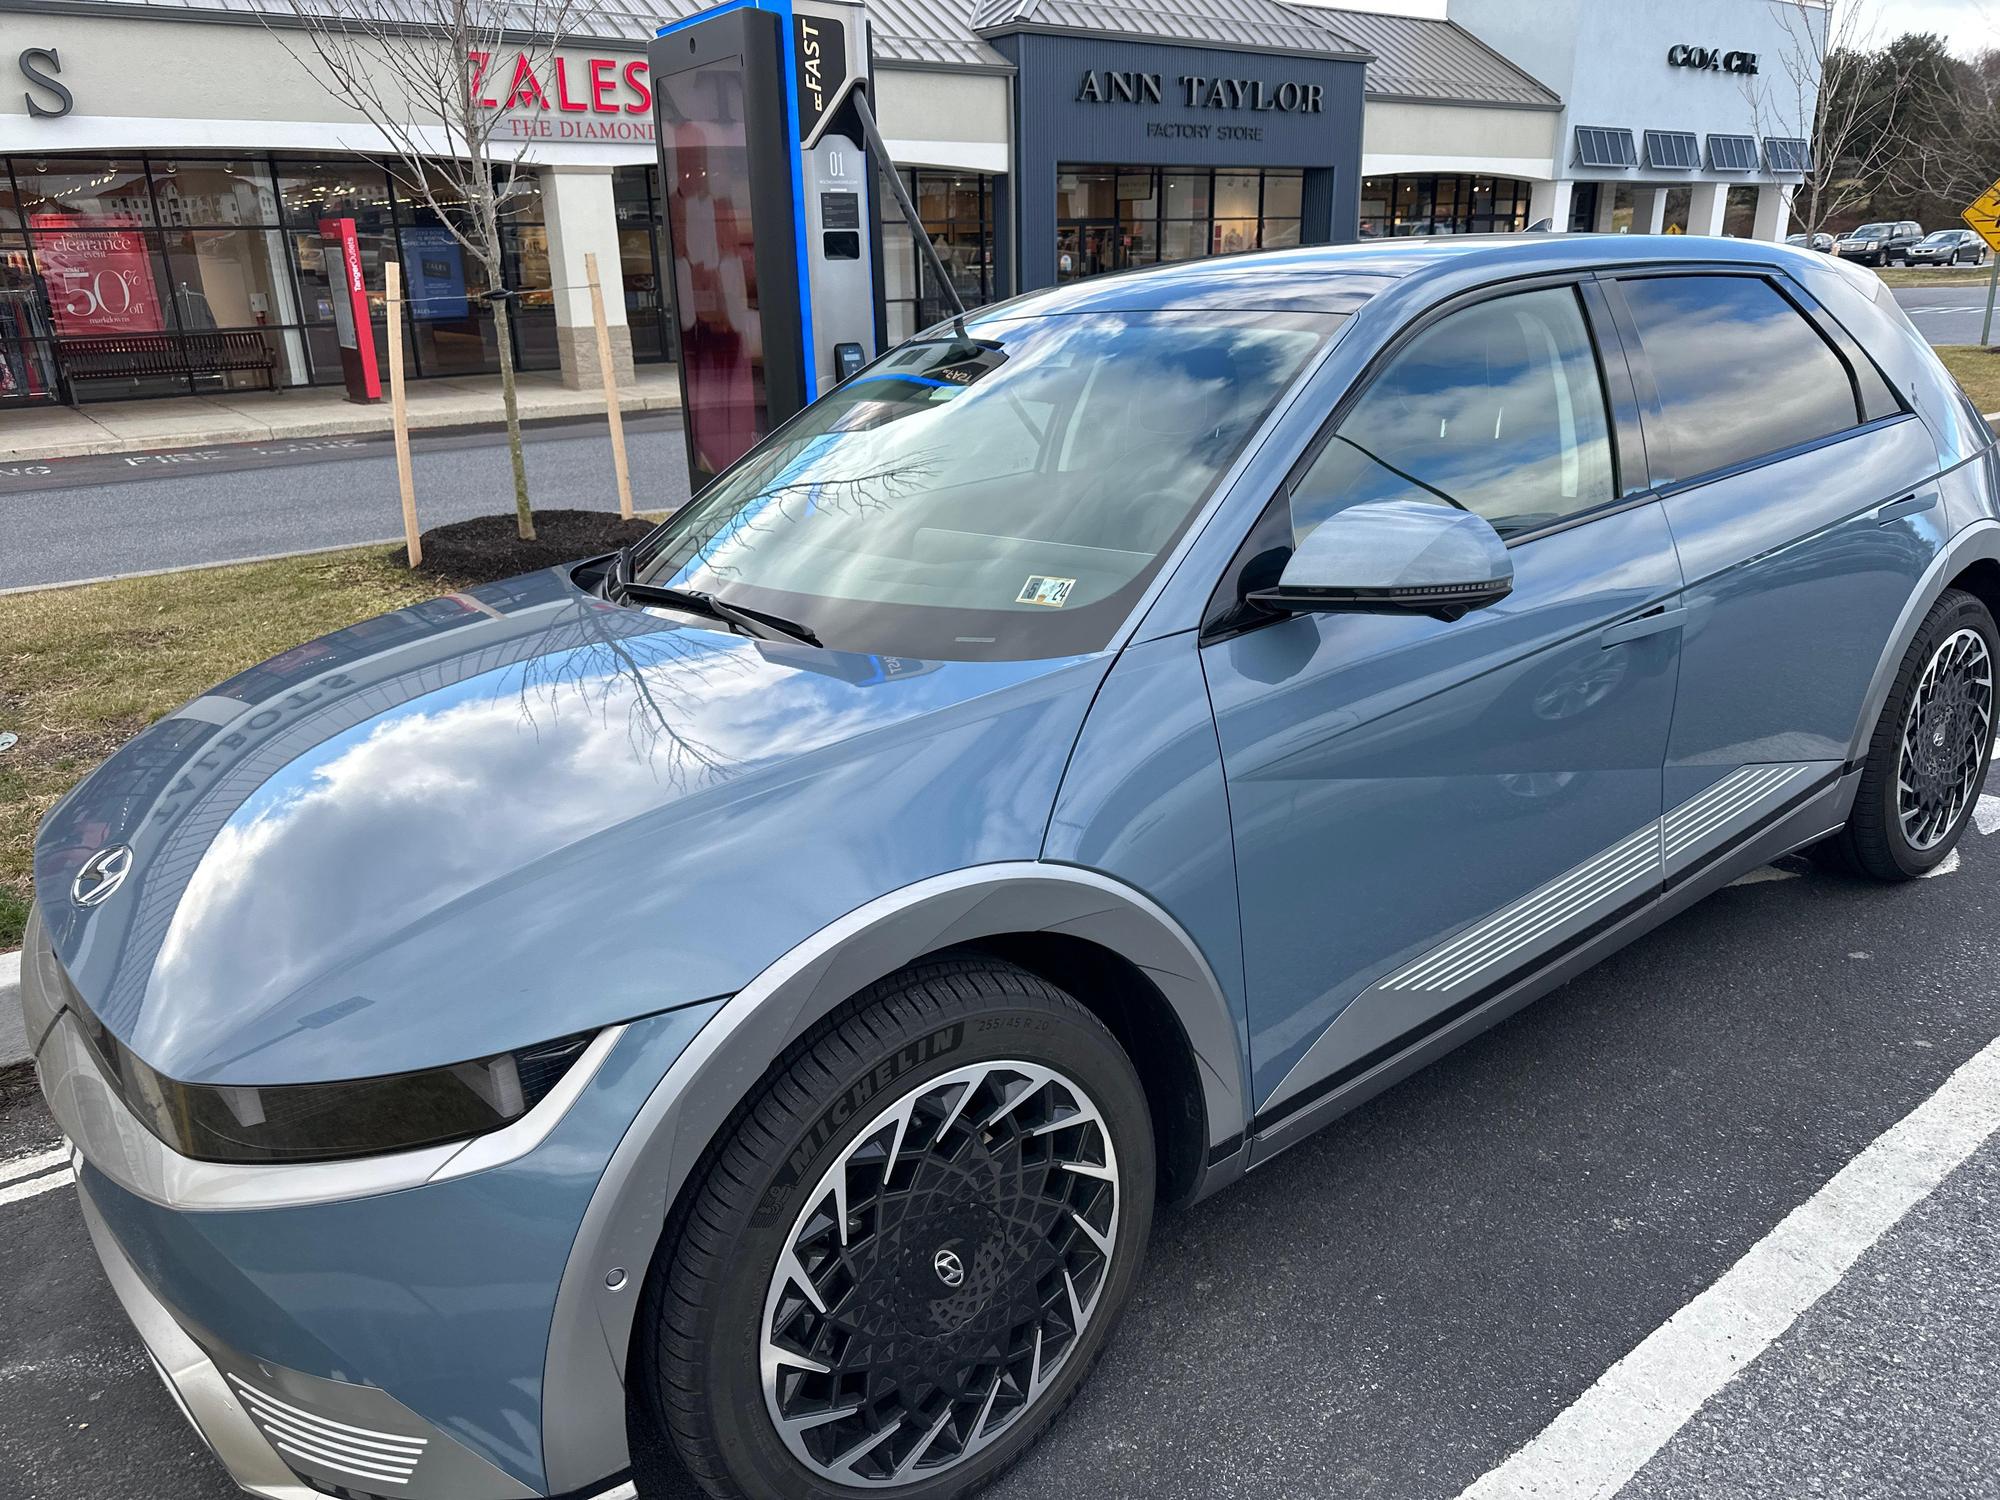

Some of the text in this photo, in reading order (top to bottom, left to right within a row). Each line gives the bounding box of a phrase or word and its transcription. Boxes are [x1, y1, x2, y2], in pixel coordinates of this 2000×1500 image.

[1668, 44, 1762, 74] COACH
[19, 47, 74, 118] S
[468, 51, 652, 114] ZALES
[1076, 69, 1324, 113] ANN TAYLOR
[508, 119, 553, 137] THE
[1147, 122, 1265, 142] FACTORY STORE
[830, 151, 845, 177] 01
[53, 235, 131, 252] clearance
[129, 303, 144, 314] off
[1051, 582, 1072, 602] 24
[788, 1027, 956, 1177] MICHELIN
